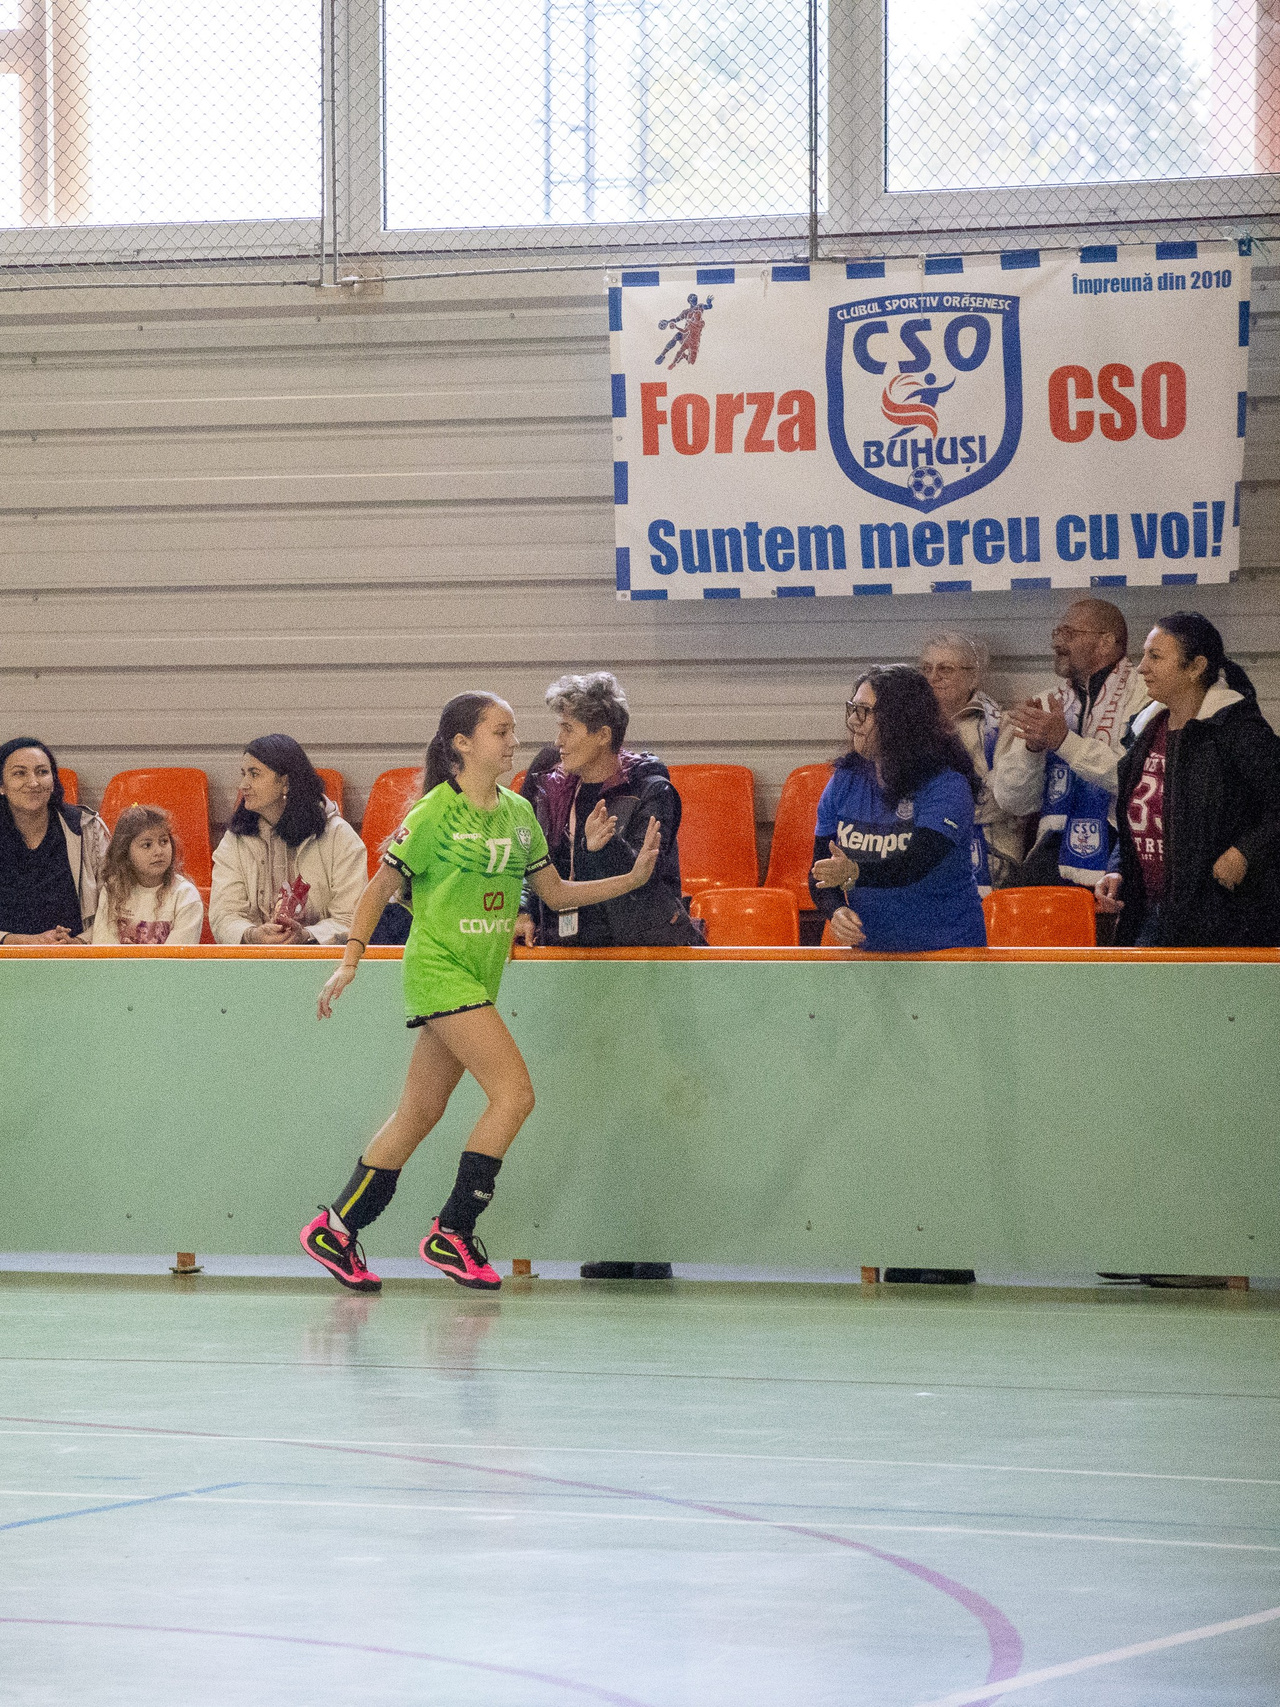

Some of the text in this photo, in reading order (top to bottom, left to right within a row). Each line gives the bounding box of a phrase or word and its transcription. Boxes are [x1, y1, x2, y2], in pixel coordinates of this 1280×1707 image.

[1071, 269, 1232, 296] Împreună din 2010
[836, 303, 885, 320] CLUBUL
[885, 296, 939, 311] SPORTIV
[852, 313, 991, 375] CSO
[640, 382, 817, 456] Forza
[1048, 361, 1187, 443] CSO
[862, 434, 987, 473] BUHUȘI
[647, 501, 1227, 575] Suntem mereu cu voi!
[485, 838, 512, 873] 17
